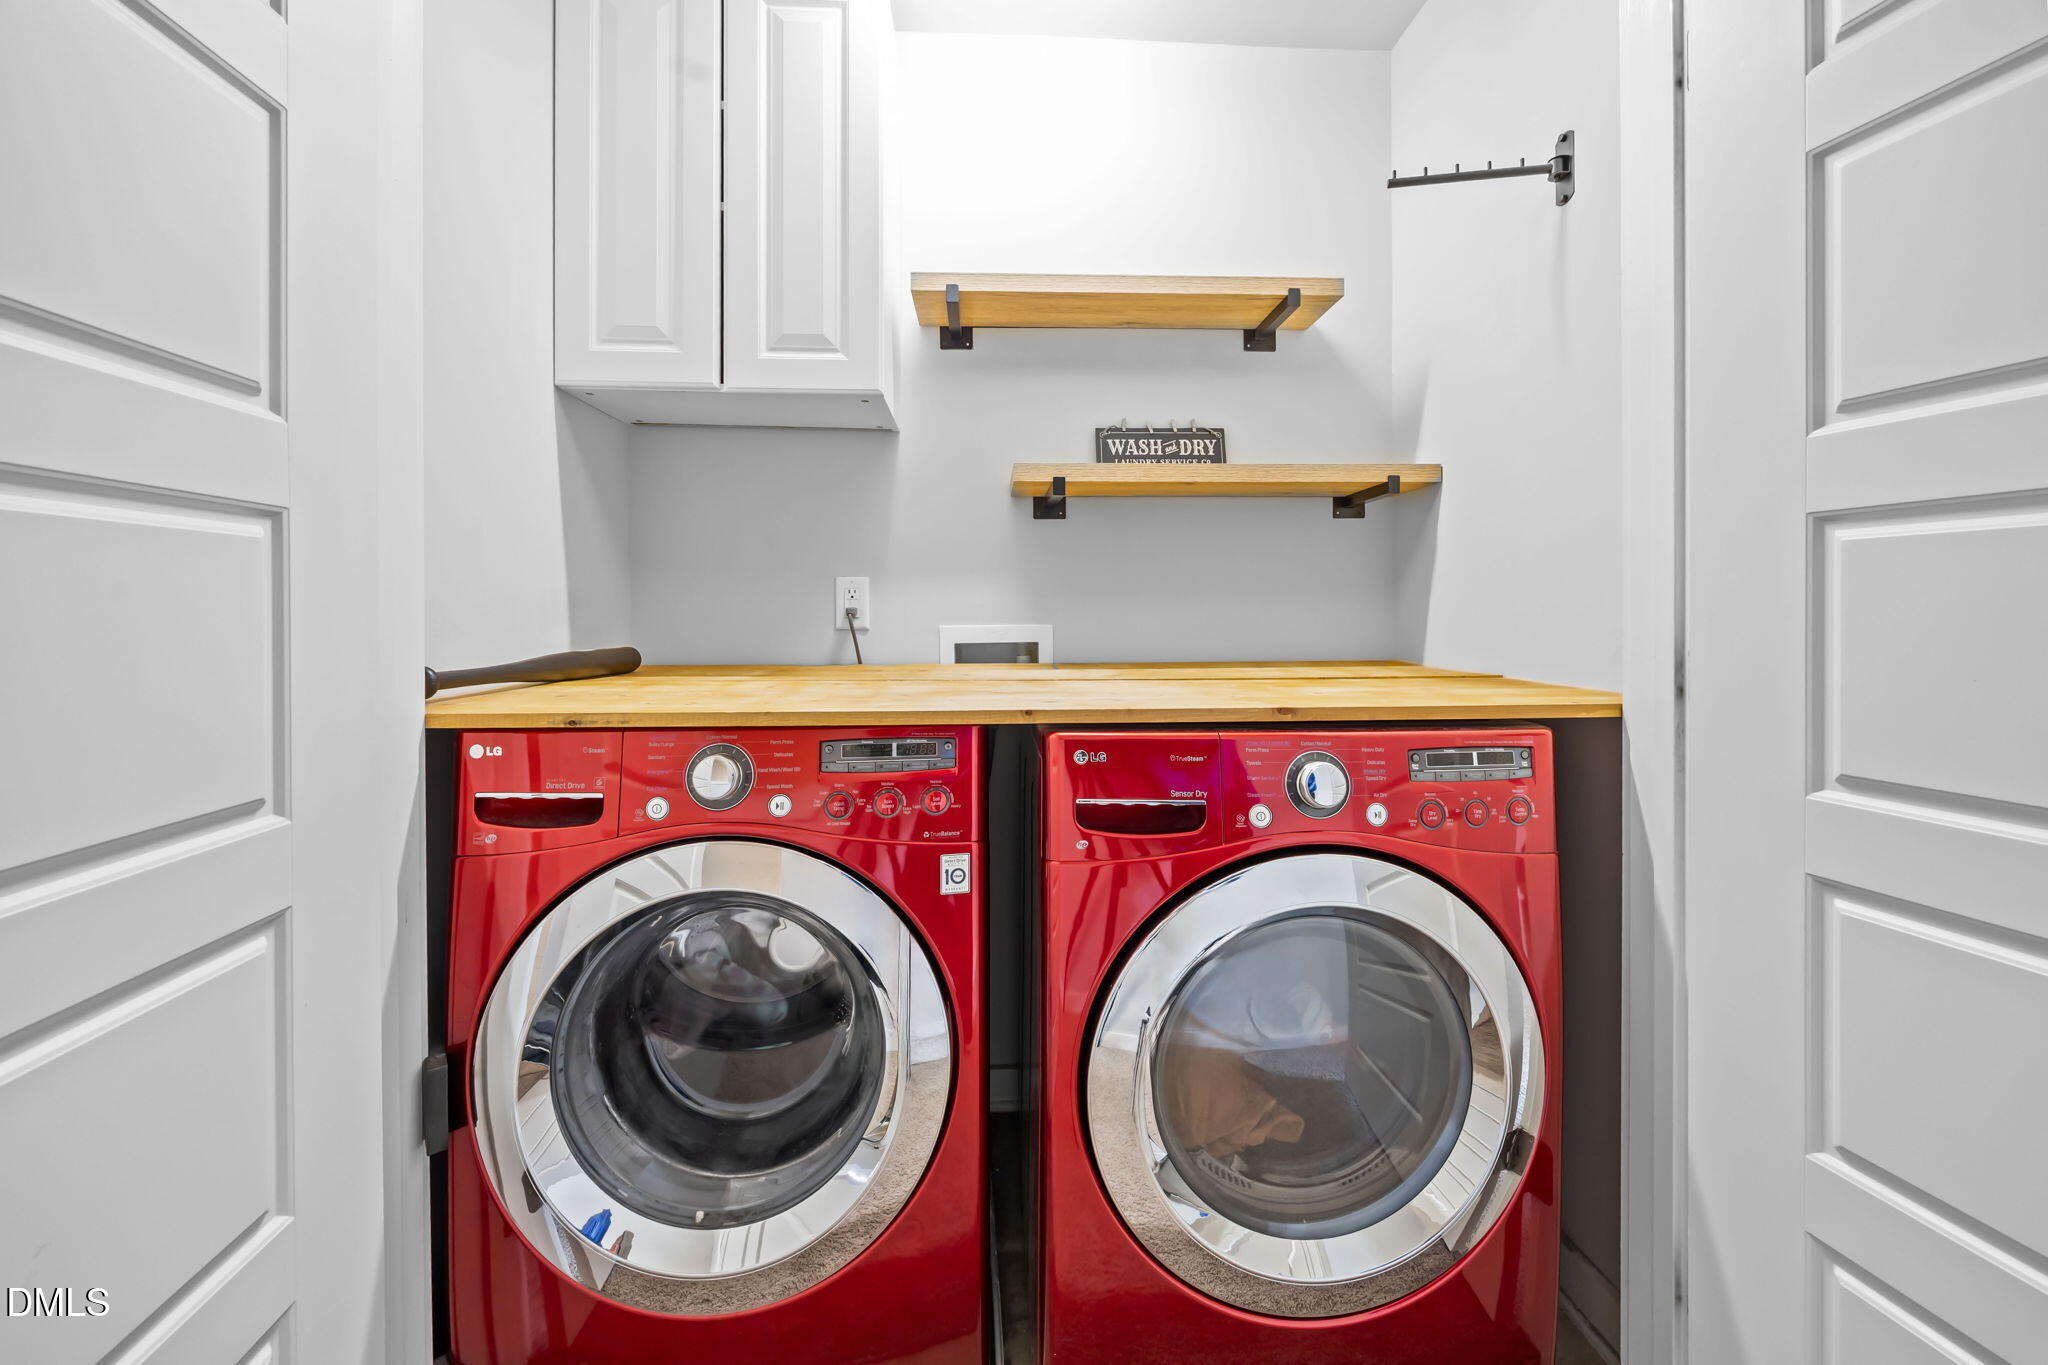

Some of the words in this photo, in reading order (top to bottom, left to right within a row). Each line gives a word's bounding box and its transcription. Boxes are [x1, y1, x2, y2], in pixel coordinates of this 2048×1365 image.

[1106, 439, 1163, 456] WASH
[1179, 439, 1217, 456] DRY
[485, 746, 502, 756] LG
[1090, 752, 1107, 762] LG
[1196, 790, 1208, 798] Dry
[945, 867, 966, 885] 10
